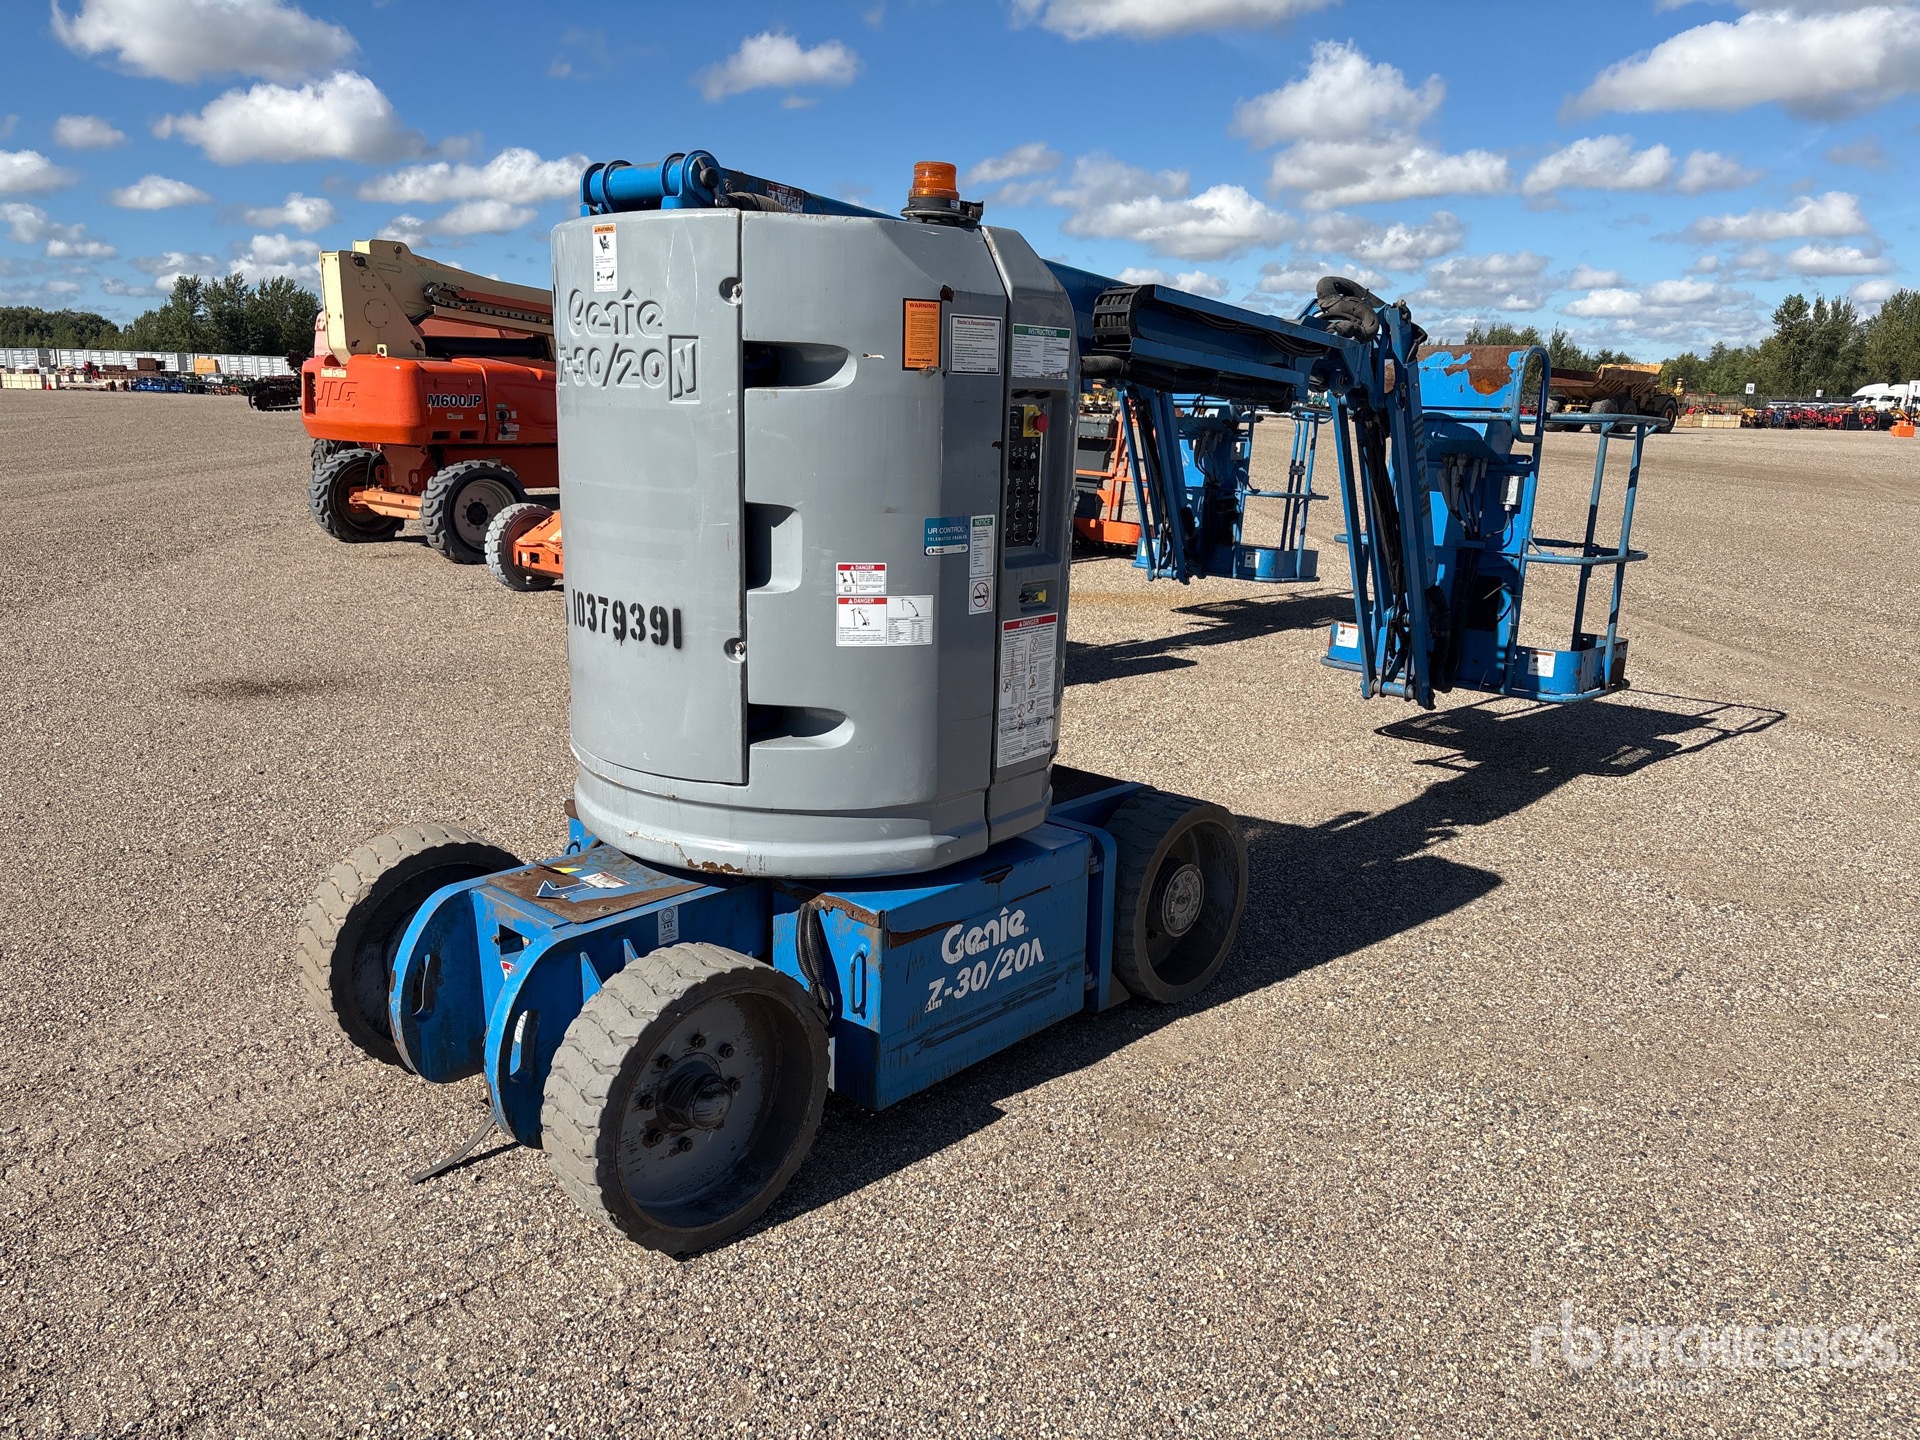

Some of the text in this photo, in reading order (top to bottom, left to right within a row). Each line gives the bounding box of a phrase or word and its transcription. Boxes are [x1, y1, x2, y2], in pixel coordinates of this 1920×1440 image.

[568, 288, 664, 339] Genie
[1027, 327, 1058, 337] INSTRUCTIONS
[427, 394, 482, 408] M600JP
[974, 518, 991, 526] NOTICE
[938, 525, 965, 534] CONTROL
[572, 588, 683, 650] 10379391
[1022, 618, 1040, 626] DANGER
[941, 906, 1027, 965] Genie
